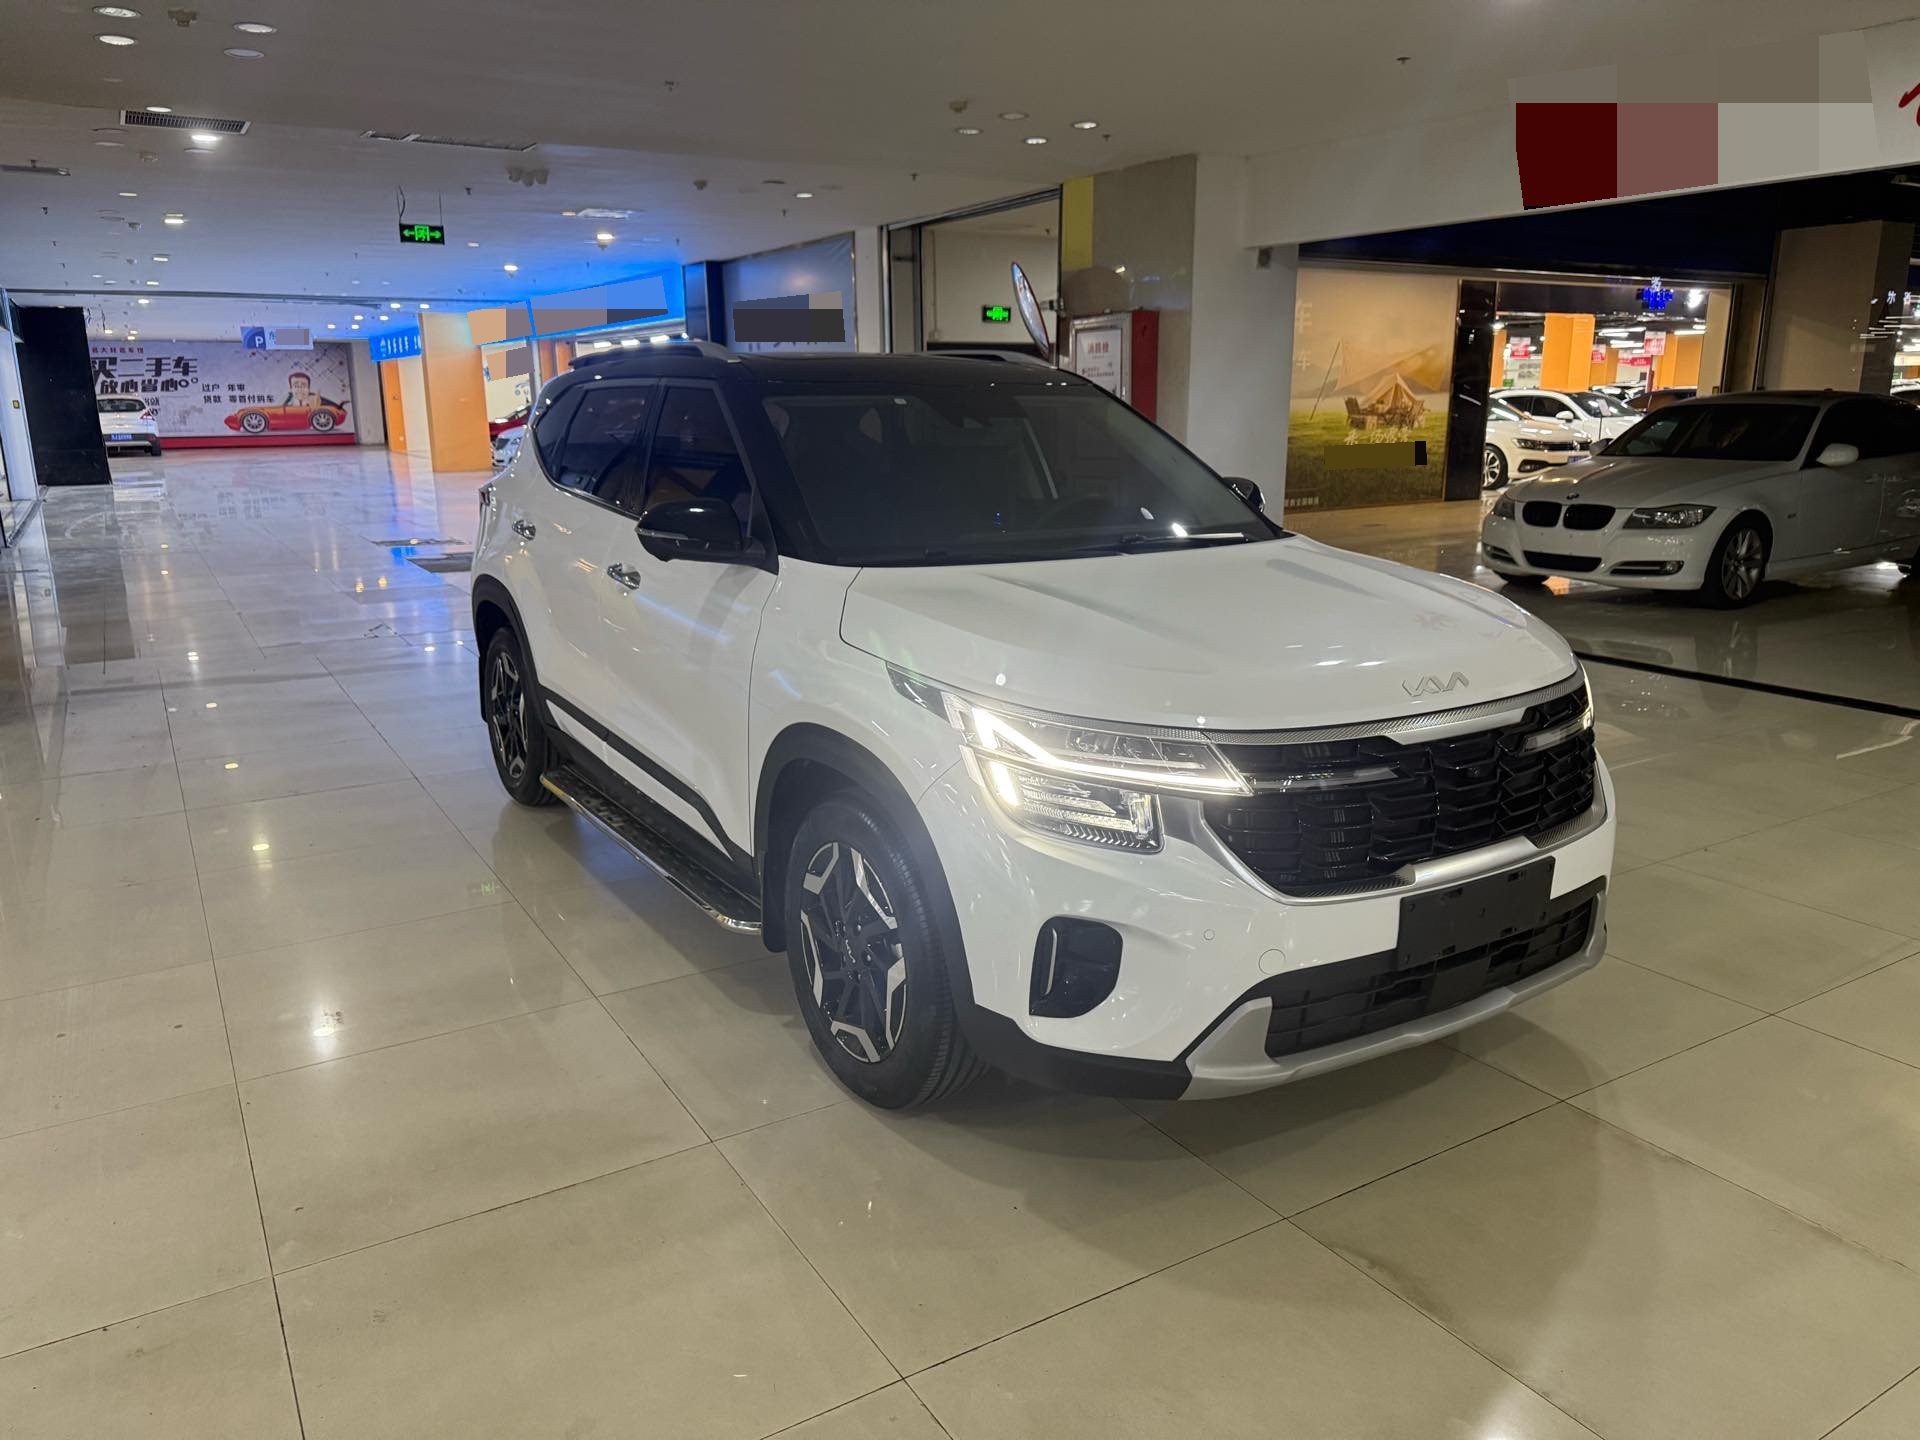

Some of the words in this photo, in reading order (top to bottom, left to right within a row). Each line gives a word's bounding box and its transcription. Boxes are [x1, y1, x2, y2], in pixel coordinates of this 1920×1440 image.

[91, 357, 198, 379] 买二手车
[202, 384, 220, 392] 过户
[1402, 672, 1469, 697] KIA
